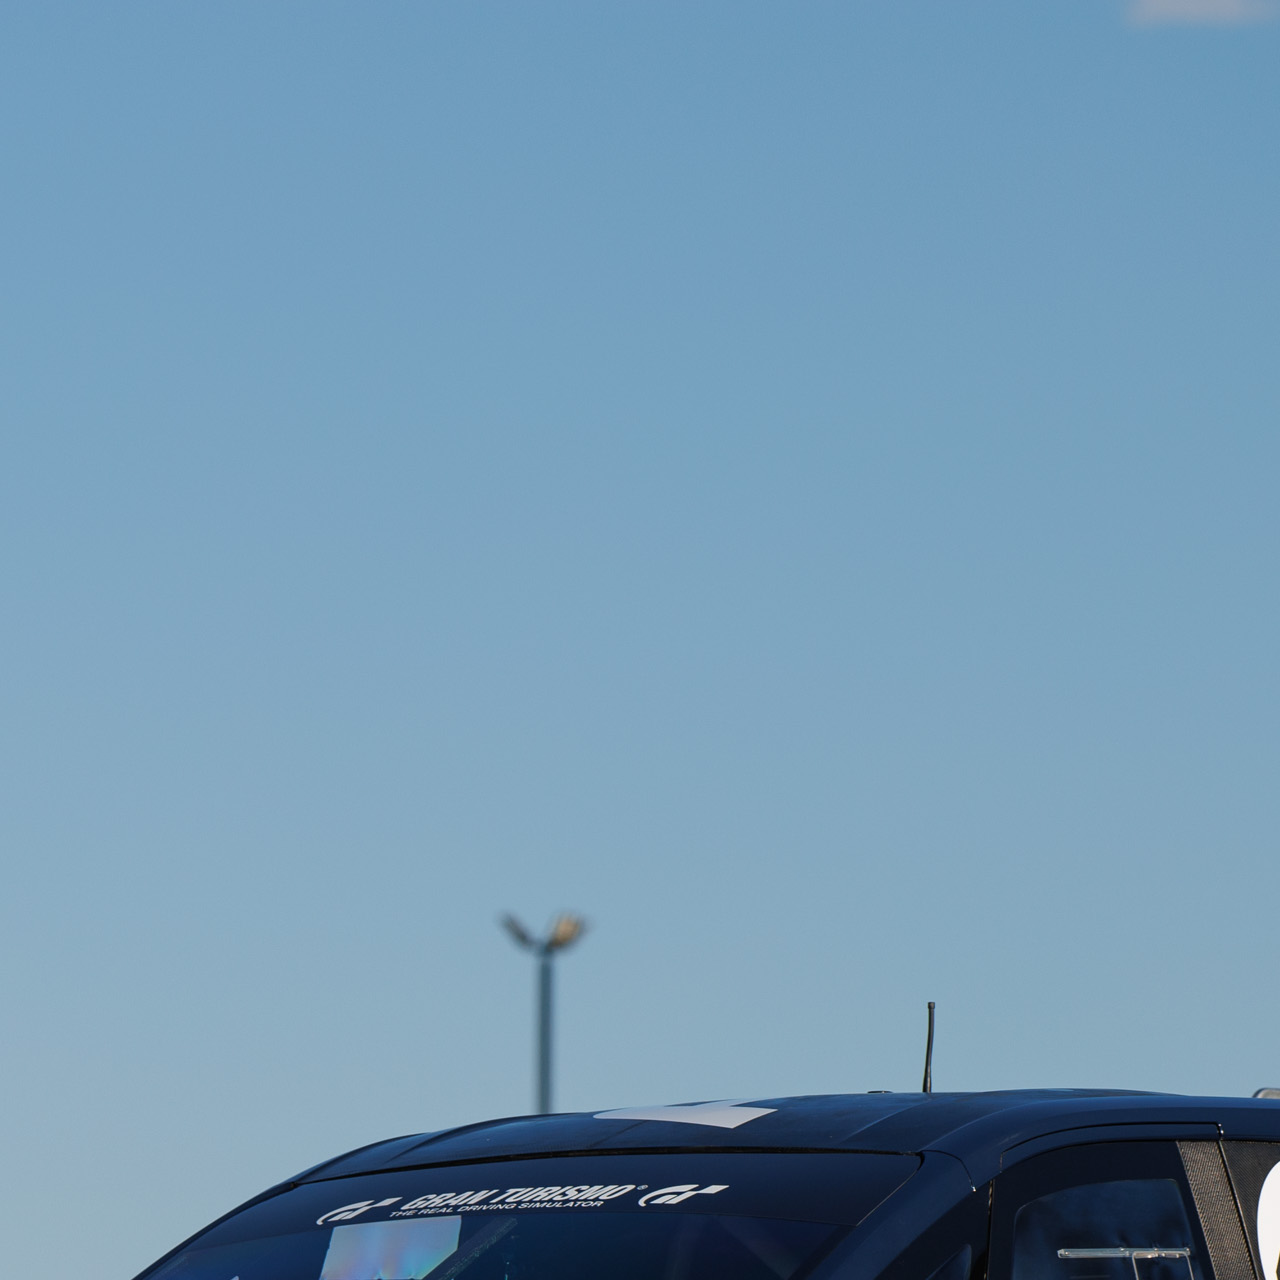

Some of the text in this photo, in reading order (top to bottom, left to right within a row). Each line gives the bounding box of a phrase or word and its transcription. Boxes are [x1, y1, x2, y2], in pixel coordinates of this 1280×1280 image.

[389, 1200, 605, 1218] THE REAL DRIVING SIMULATOR
[400, 1189, 499, 1210] GRAN
